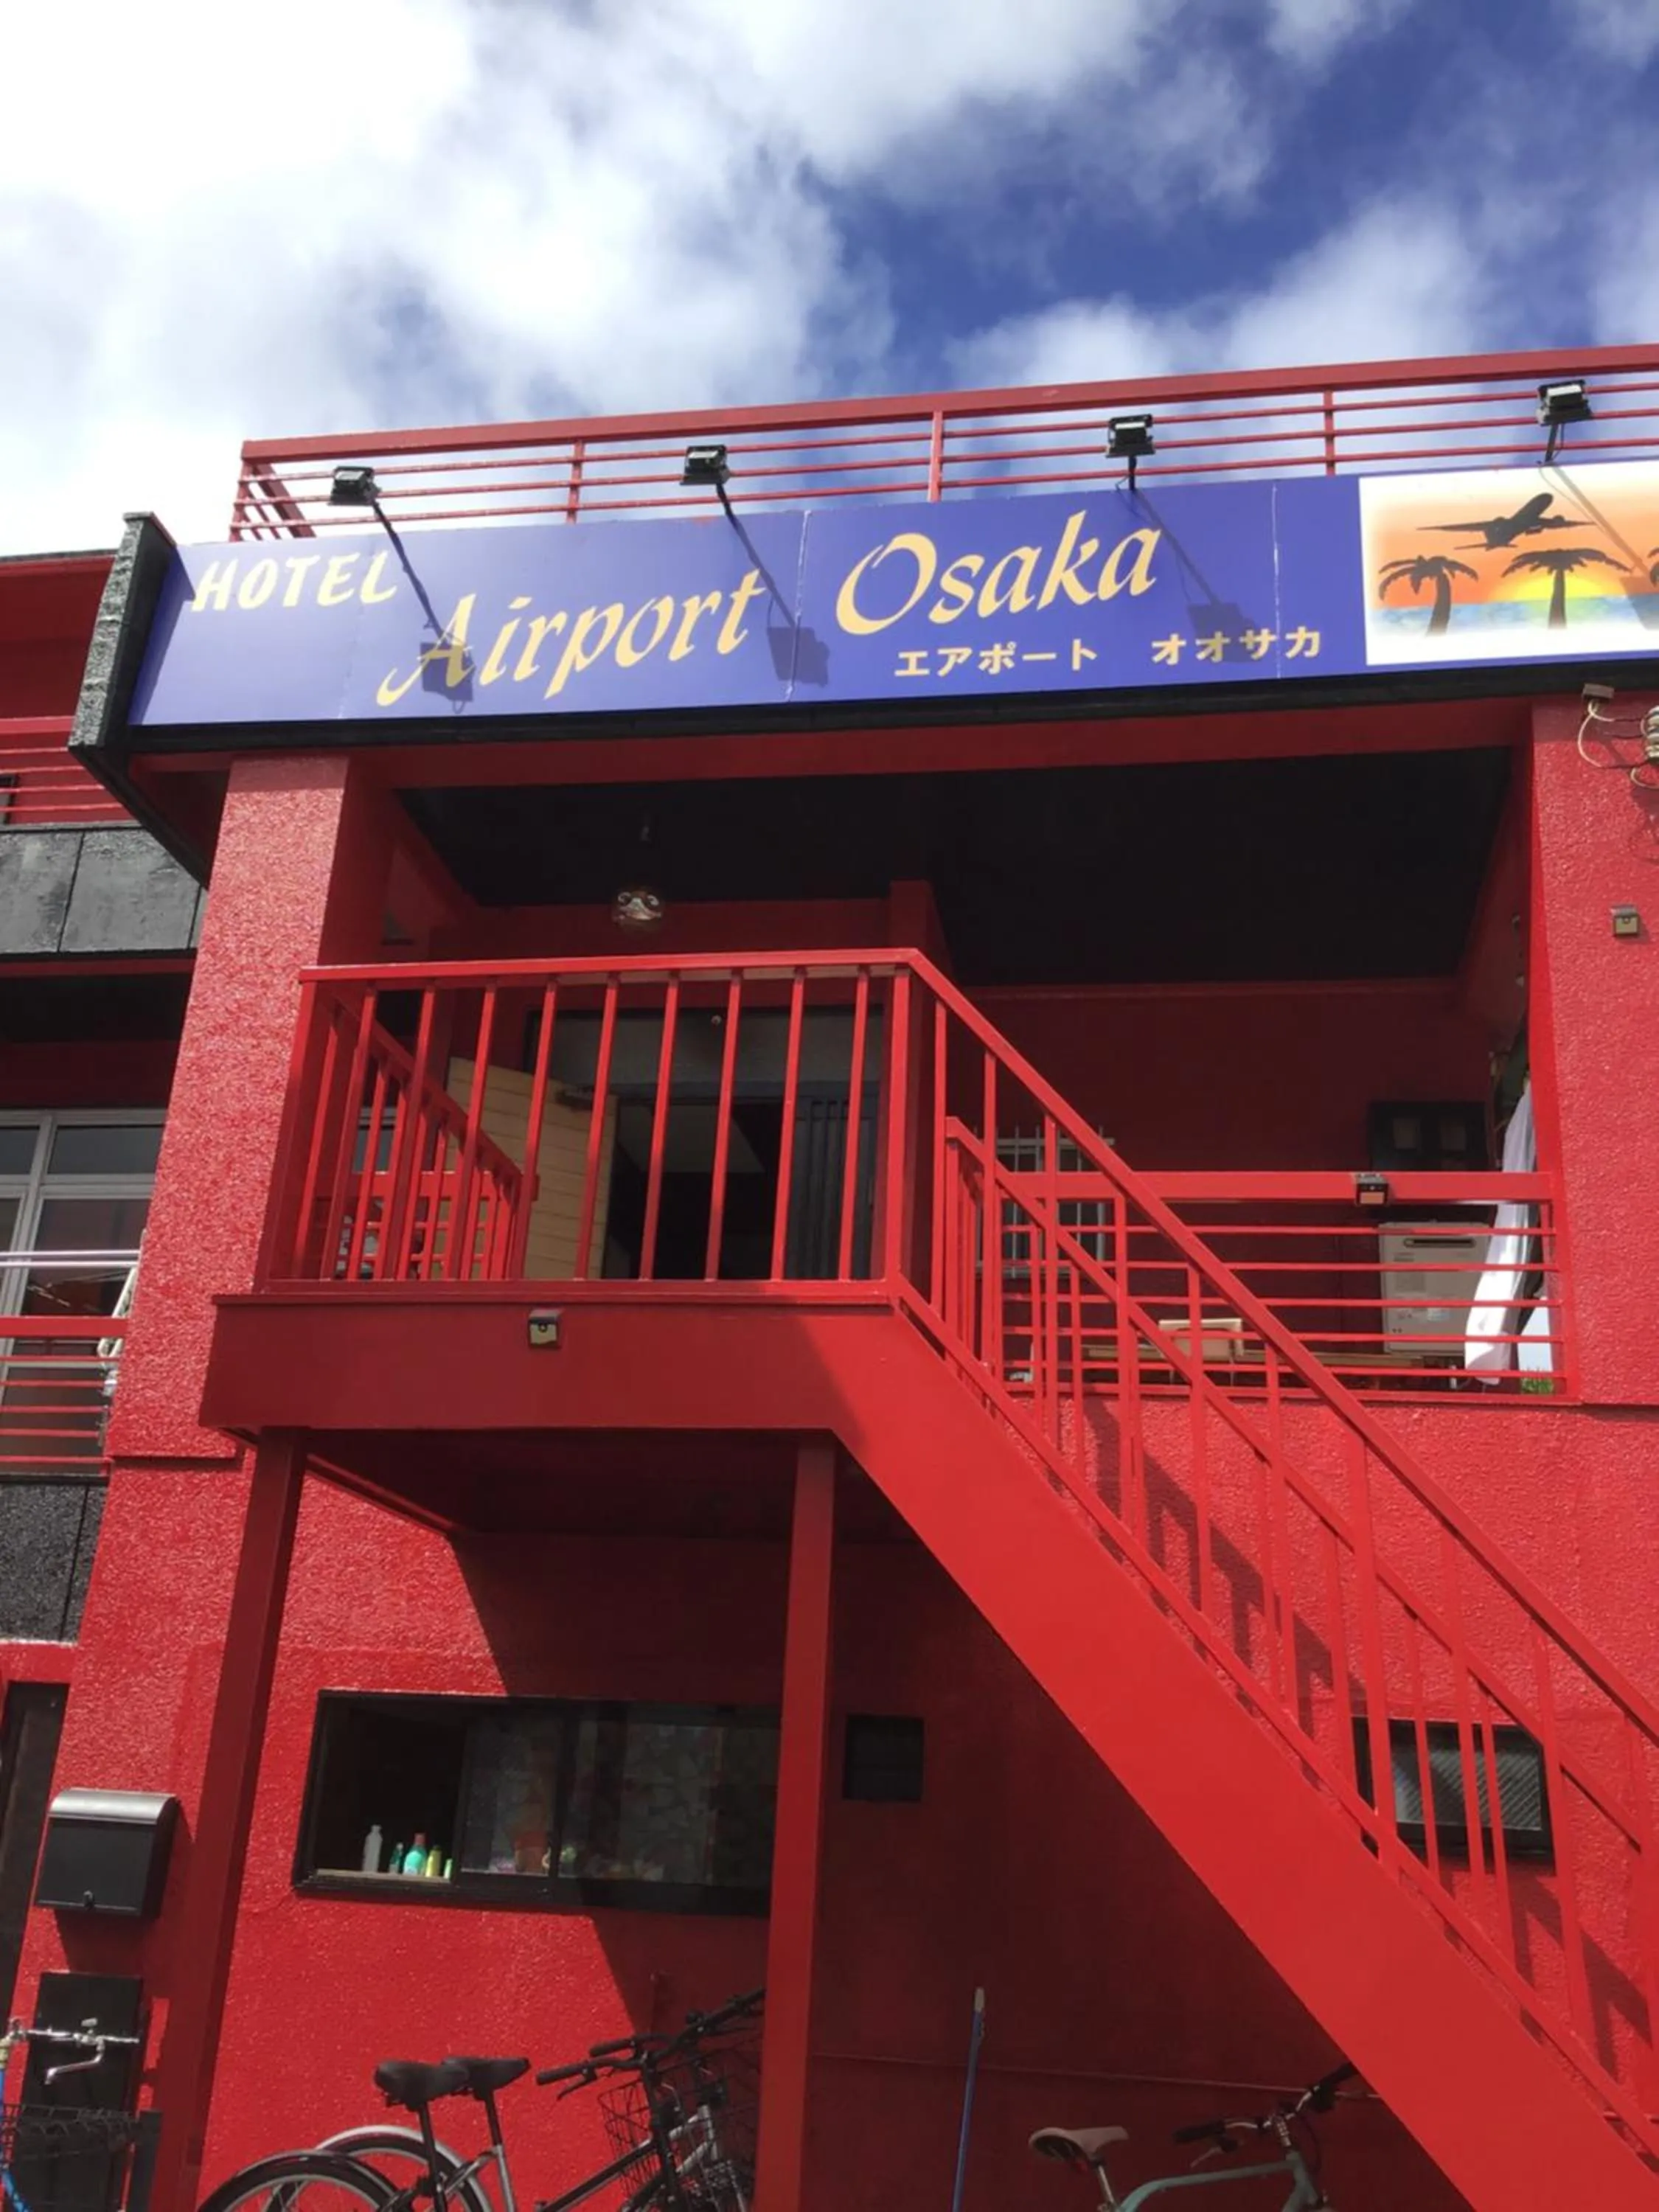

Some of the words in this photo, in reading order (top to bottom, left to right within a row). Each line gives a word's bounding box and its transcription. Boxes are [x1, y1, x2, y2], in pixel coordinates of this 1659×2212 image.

[191, 549, 397, 613] HOTEL
[375, 568, 765, 707] Airport
[835, 509, 1161, 636] Osaka
[894, 638, 1098, 678] エアポート
[1152, 625, 1322, 666] オオサカ
